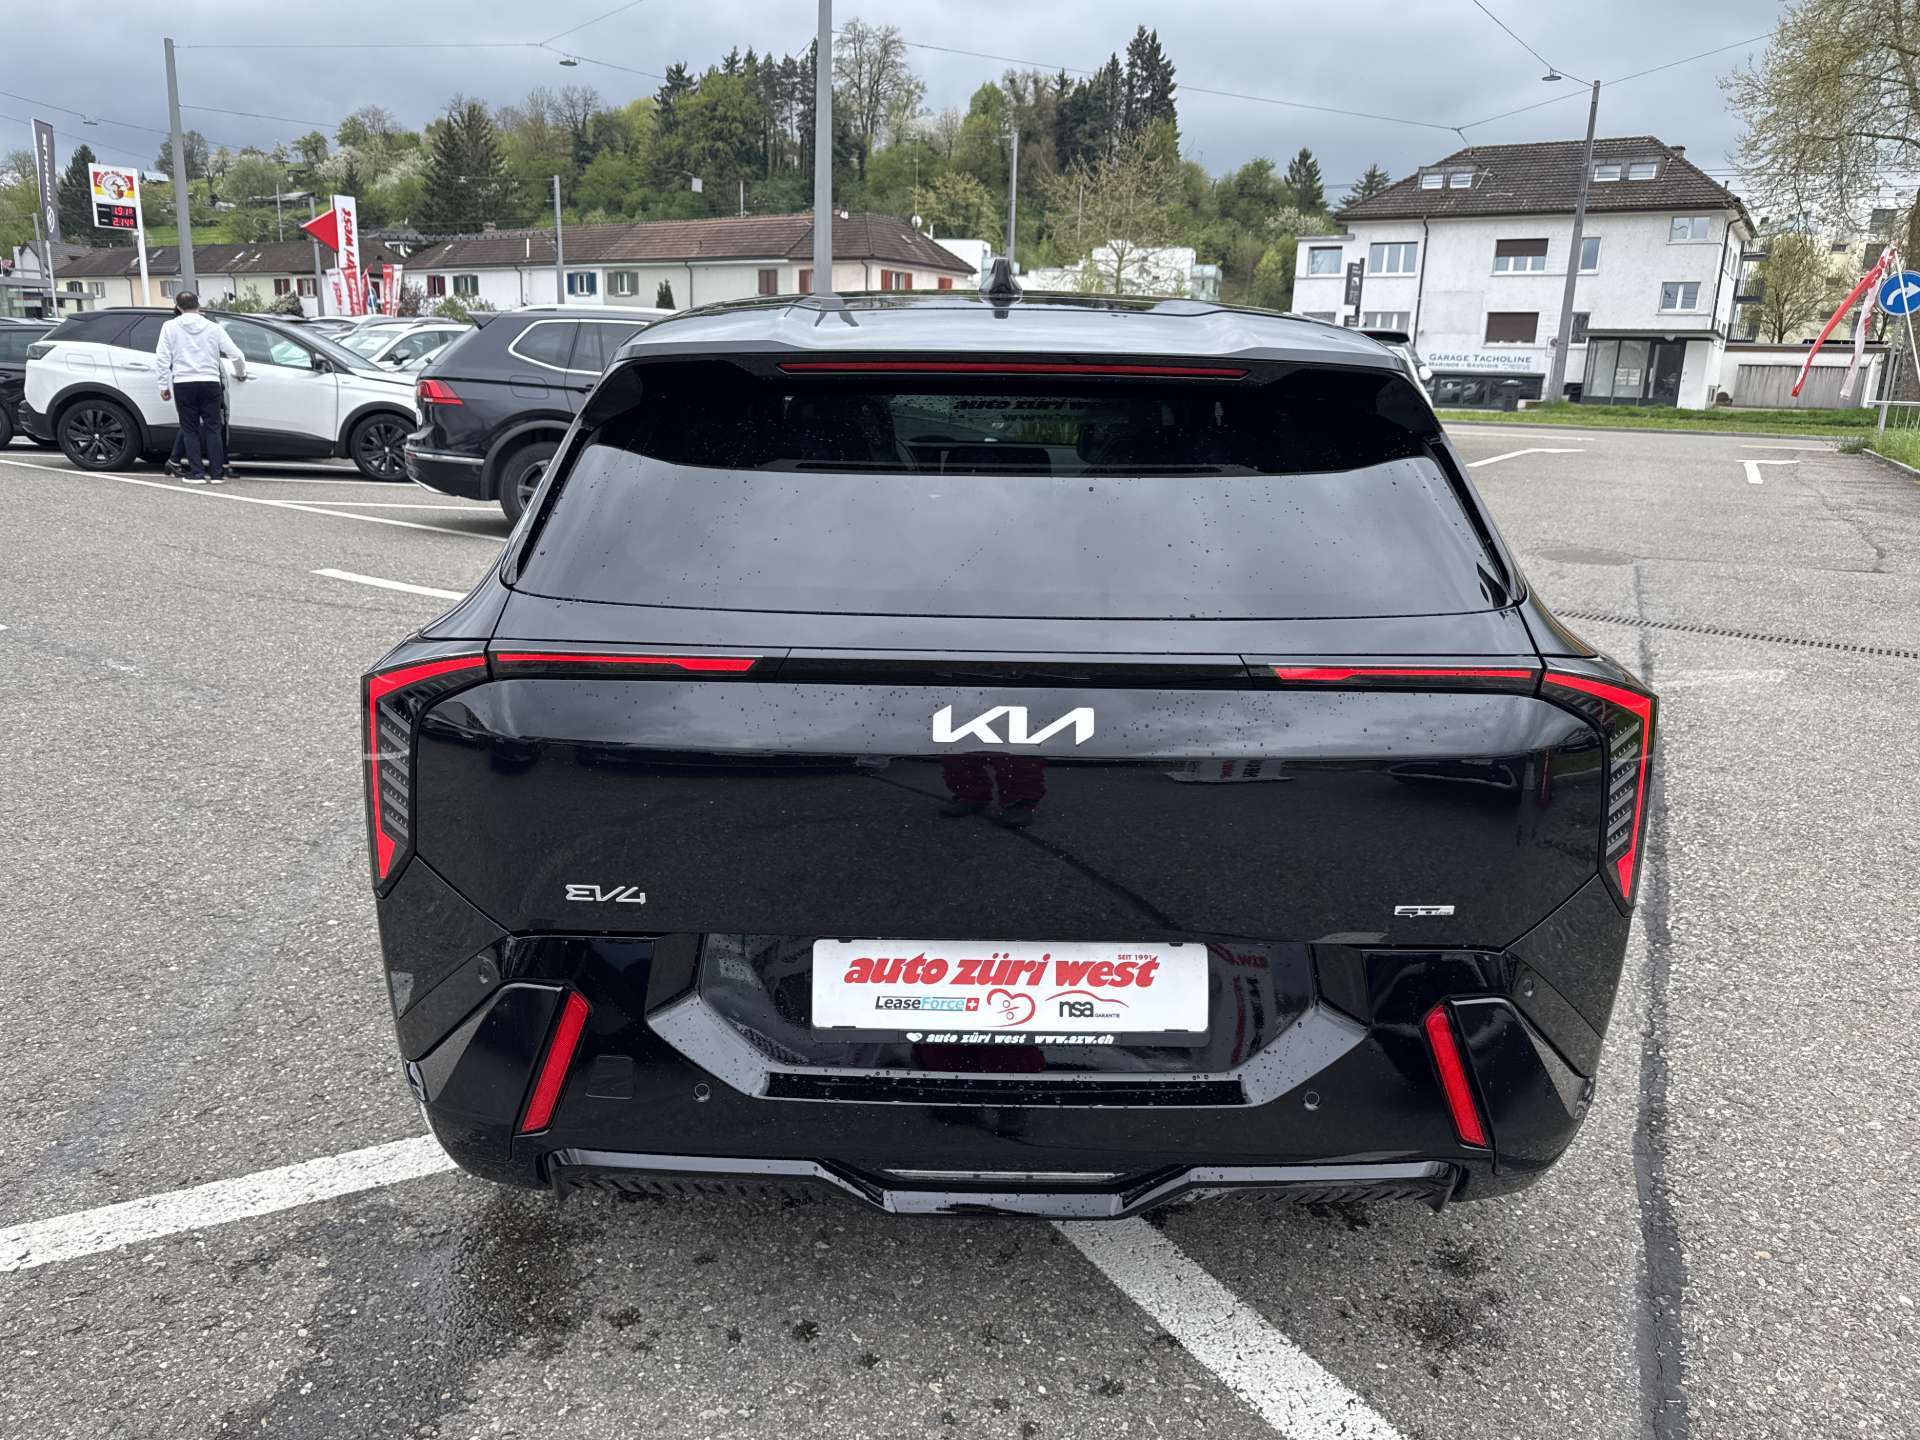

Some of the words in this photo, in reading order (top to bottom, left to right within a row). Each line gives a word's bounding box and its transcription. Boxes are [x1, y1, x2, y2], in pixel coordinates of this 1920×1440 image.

[1428, 353, 1469, 362] GARAGE
[1473, 354, 1532, 364] TACHOLINE
[932, 704, 1095, 745] KIA
[565, 884, 647, 905] EV4
[1117, 953, 1132, 961] SEIT
[844, 952, 949, 985] auto
[950, 952, 1051, 986] züri
[1055, 955, 1161, 988] west
[875, 995, 965, 1011] LeaseForce
[1059, 1000, 1094, 1018] nsa
[926, 1033, 958, 1043] auto
[960, 1032, 991, 1043] züri
[994, 1033, 1026, 1044] west
[1034, 1033, 1115, 1045] www.azw.ch
